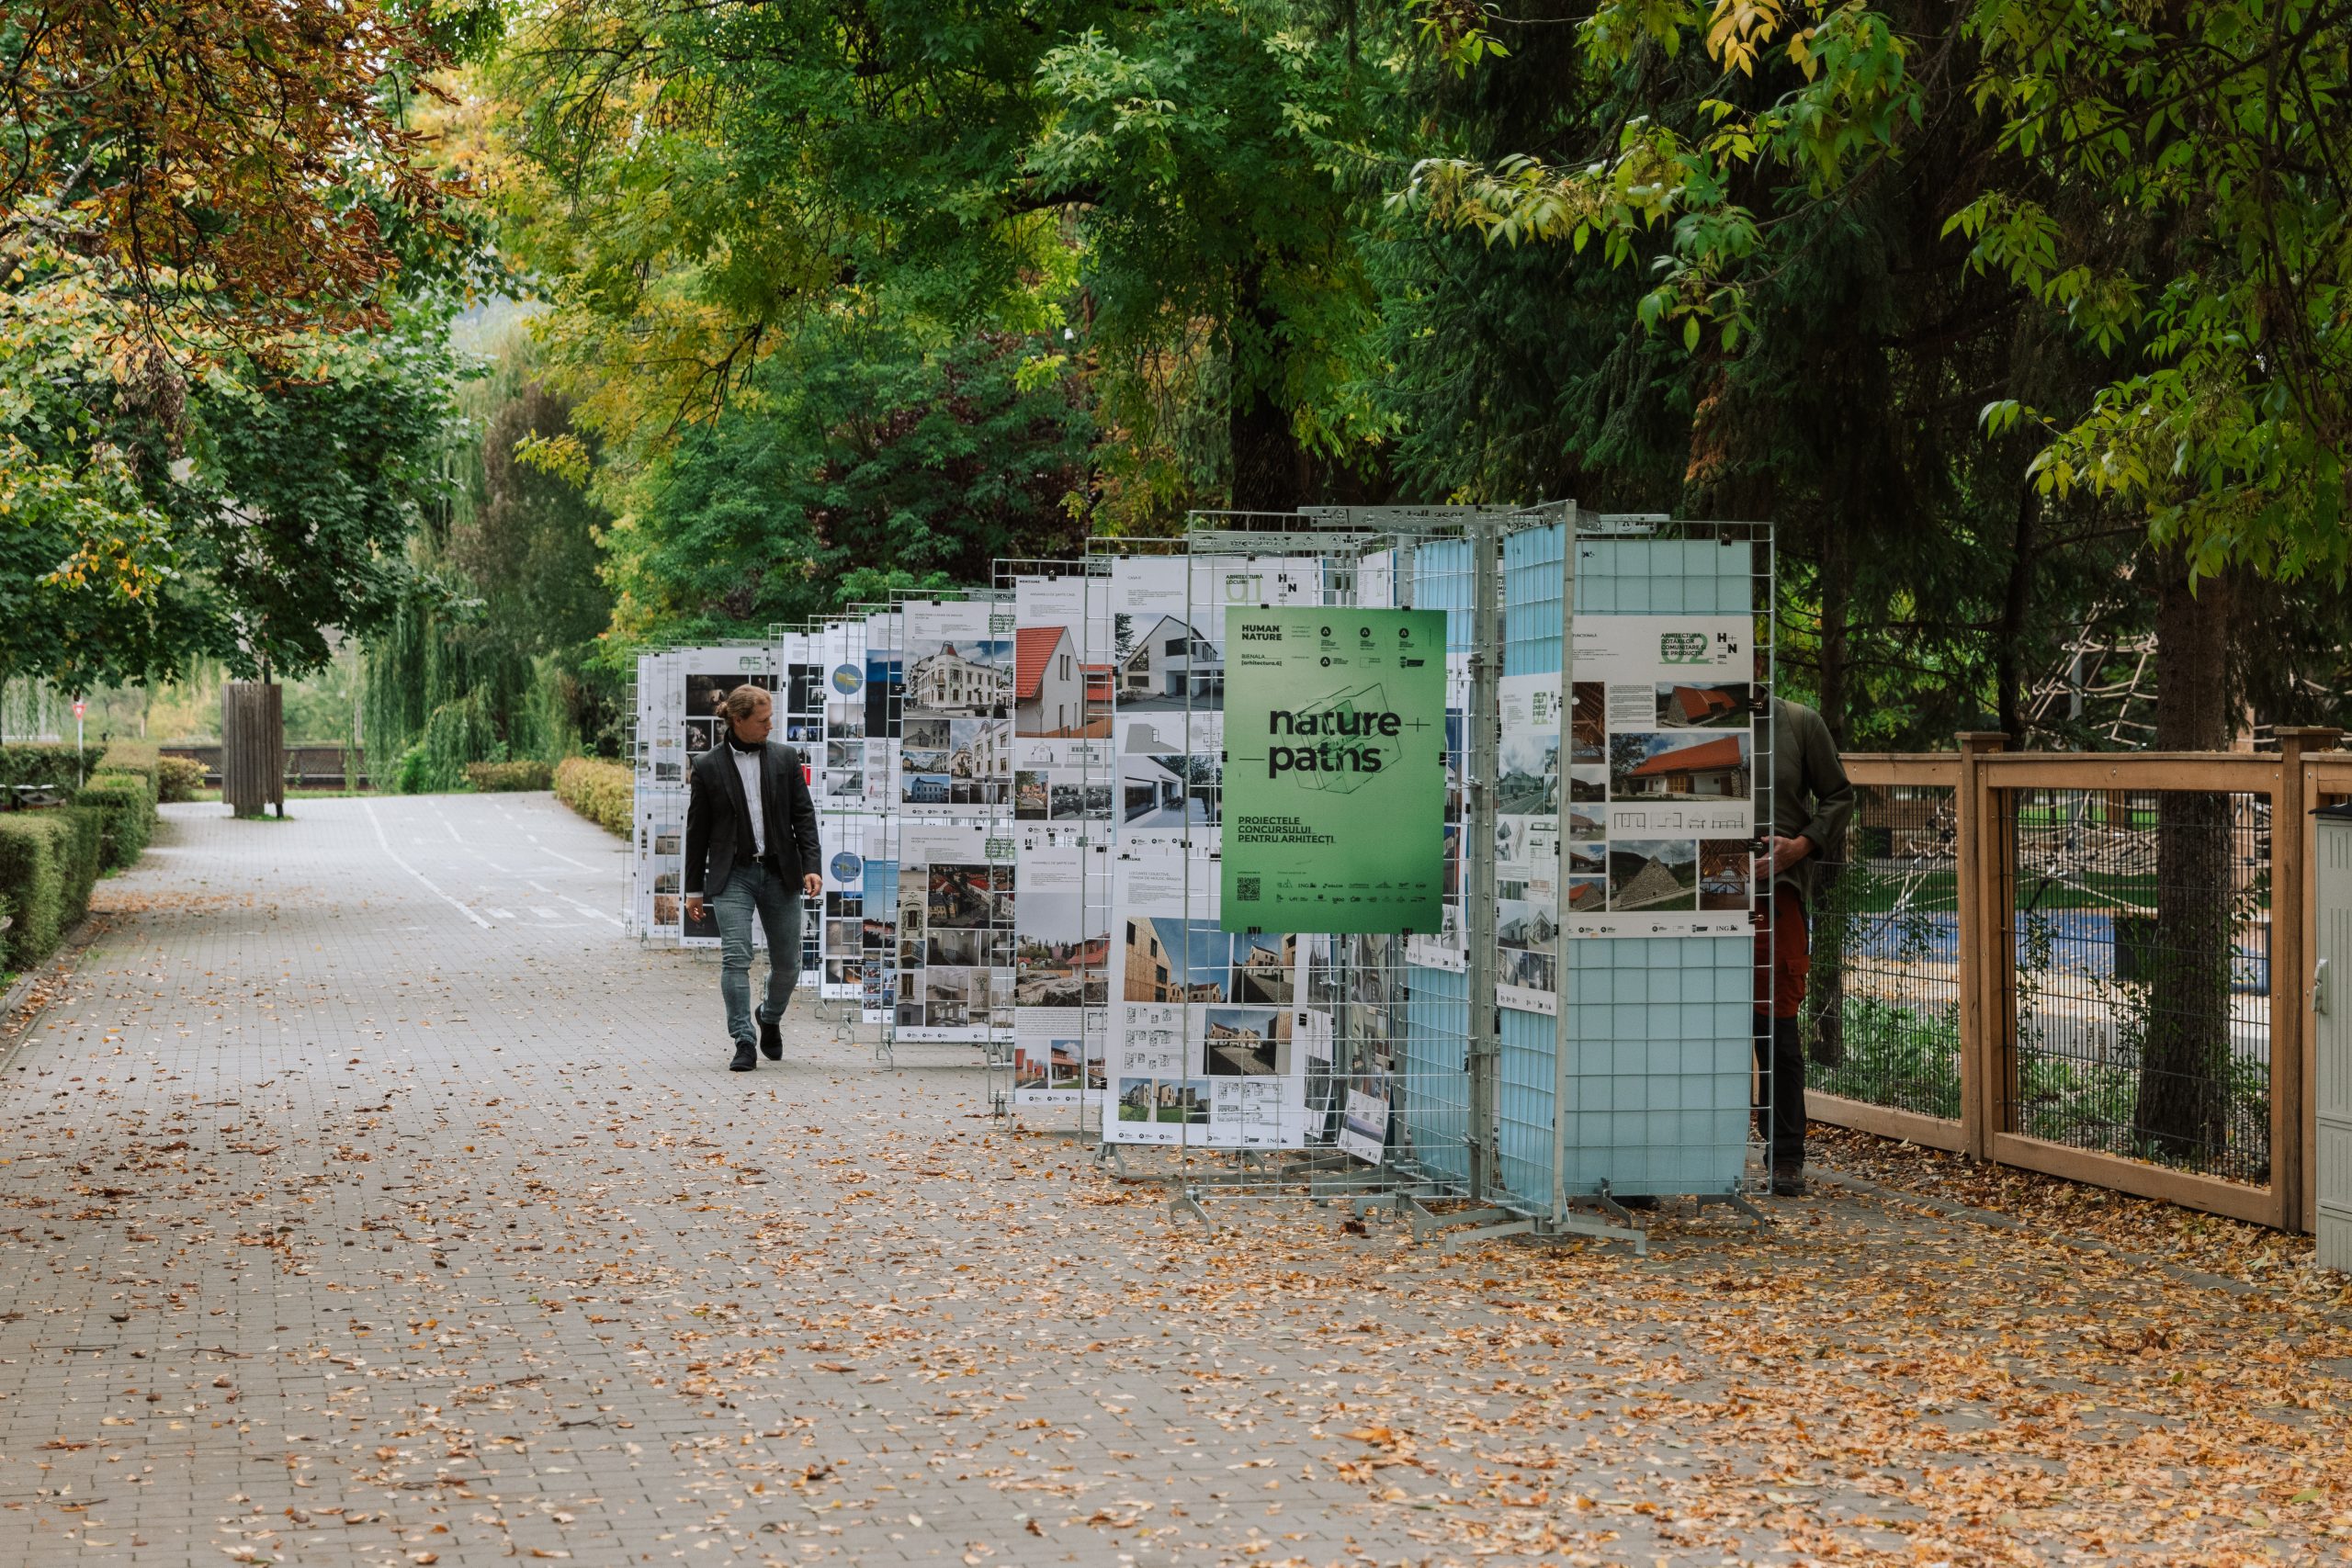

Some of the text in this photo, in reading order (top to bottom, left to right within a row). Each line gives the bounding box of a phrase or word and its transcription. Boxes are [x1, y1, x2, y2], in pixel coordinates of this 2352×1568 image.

[1288, 583, 1297, 592] N
[1241, 625, 1280, 633] HUMAN
[1241, 633, 1283, 641] NATURE
[1717, 632, 1727, 643] H
[1727, 643, 1737, 654] N
[1269, 710, 1402, 737] nature
[1269, 741, 1383, 779] paths
[1238, 816, 1300, 825] PROIECTELE
[1238, 826, 1311, 834] CONCURSULUI
[1238, 834, 1279, 843] PENTRU
